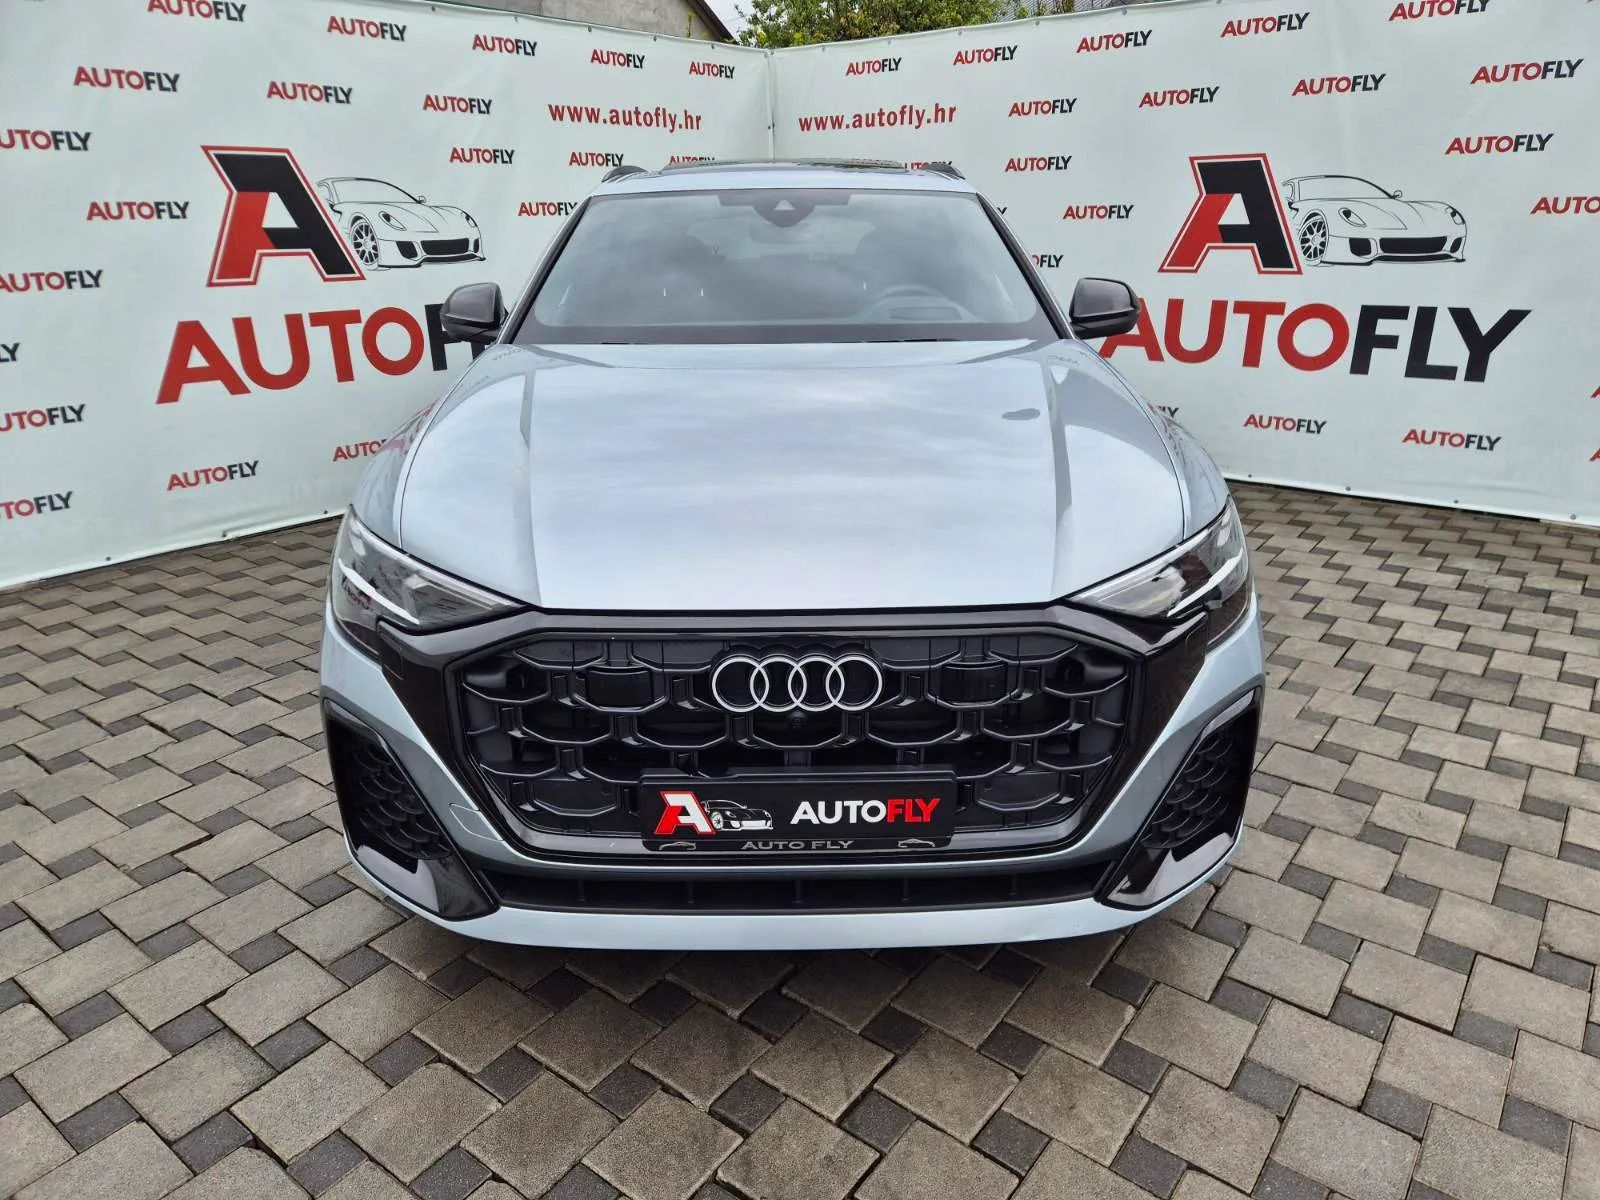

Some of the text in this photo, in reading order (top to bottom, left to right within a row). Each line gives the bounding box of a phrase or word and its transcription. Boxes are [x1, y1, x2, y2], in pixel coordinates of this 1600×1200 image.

[148, 0, 246, 22] AUTOFLY
[1389, 0, 1490, 22] AUTOFLY
[328, 16, 406, 41] AUTOFLY
[1221, 12, 1309, 37] AUTOFLY
[473, 35, 537, 56] AUTOFLY
[1077, 30, 1152, 53] AUTOFLY
[591, 50, 645, 69] AUTOFLY
[953, 45, 1017, 65] AUTOFLY
[689, 62, 734, 79] AUTOFLY
[846, 58, 901, 75] AUTOFLY
[1471, 59, 1584, 84] AUTOFLY
[74, 67, 179, 92] AUTOFLY
[1292, 74, 1386, 96] AUTOFLY
[268, 82, 352, 104] AUTOFLY
[1139, 86, 1219, 108] AUTOFLY
[423, 95, 492, 114] AUTOFLY
[1009, 98, 1077, 117] AUTOFLY
[548, 104, 701, 133] www.autofly.hr
[799, 103, 956, 131] www.autofly.hr
[0, 129, 91, 151] UTOFLY
[1445, 134, 1553, 154] AUTOFLY
[450, 148, 514, 164] AUTOFLY
[569, 151, 624, 167] AUTOFLY
[1005, 156, 1072, 172] AUTOFLY
[87, 201, 189, 220] AUTOFLY
[1063, 205, 1134, 219] AUTOFLY
[1530, 197, 1600, 215] AUTO
[1097, 297, 1532, 383] AUTOFLY
[0, 404, 86, 432] UTOFLY
[1244, 414, 1326, 434] AUTOFLY
[1403, 430, 1501, 451] AUTOFLY
[168, 461, 258, 490] AUTOFLY
[0, 491, 73, 519] TOFLY
[790, 798, 941, 825] AUTOFLY
[741, 840, 854, 851] AUTO FLY
